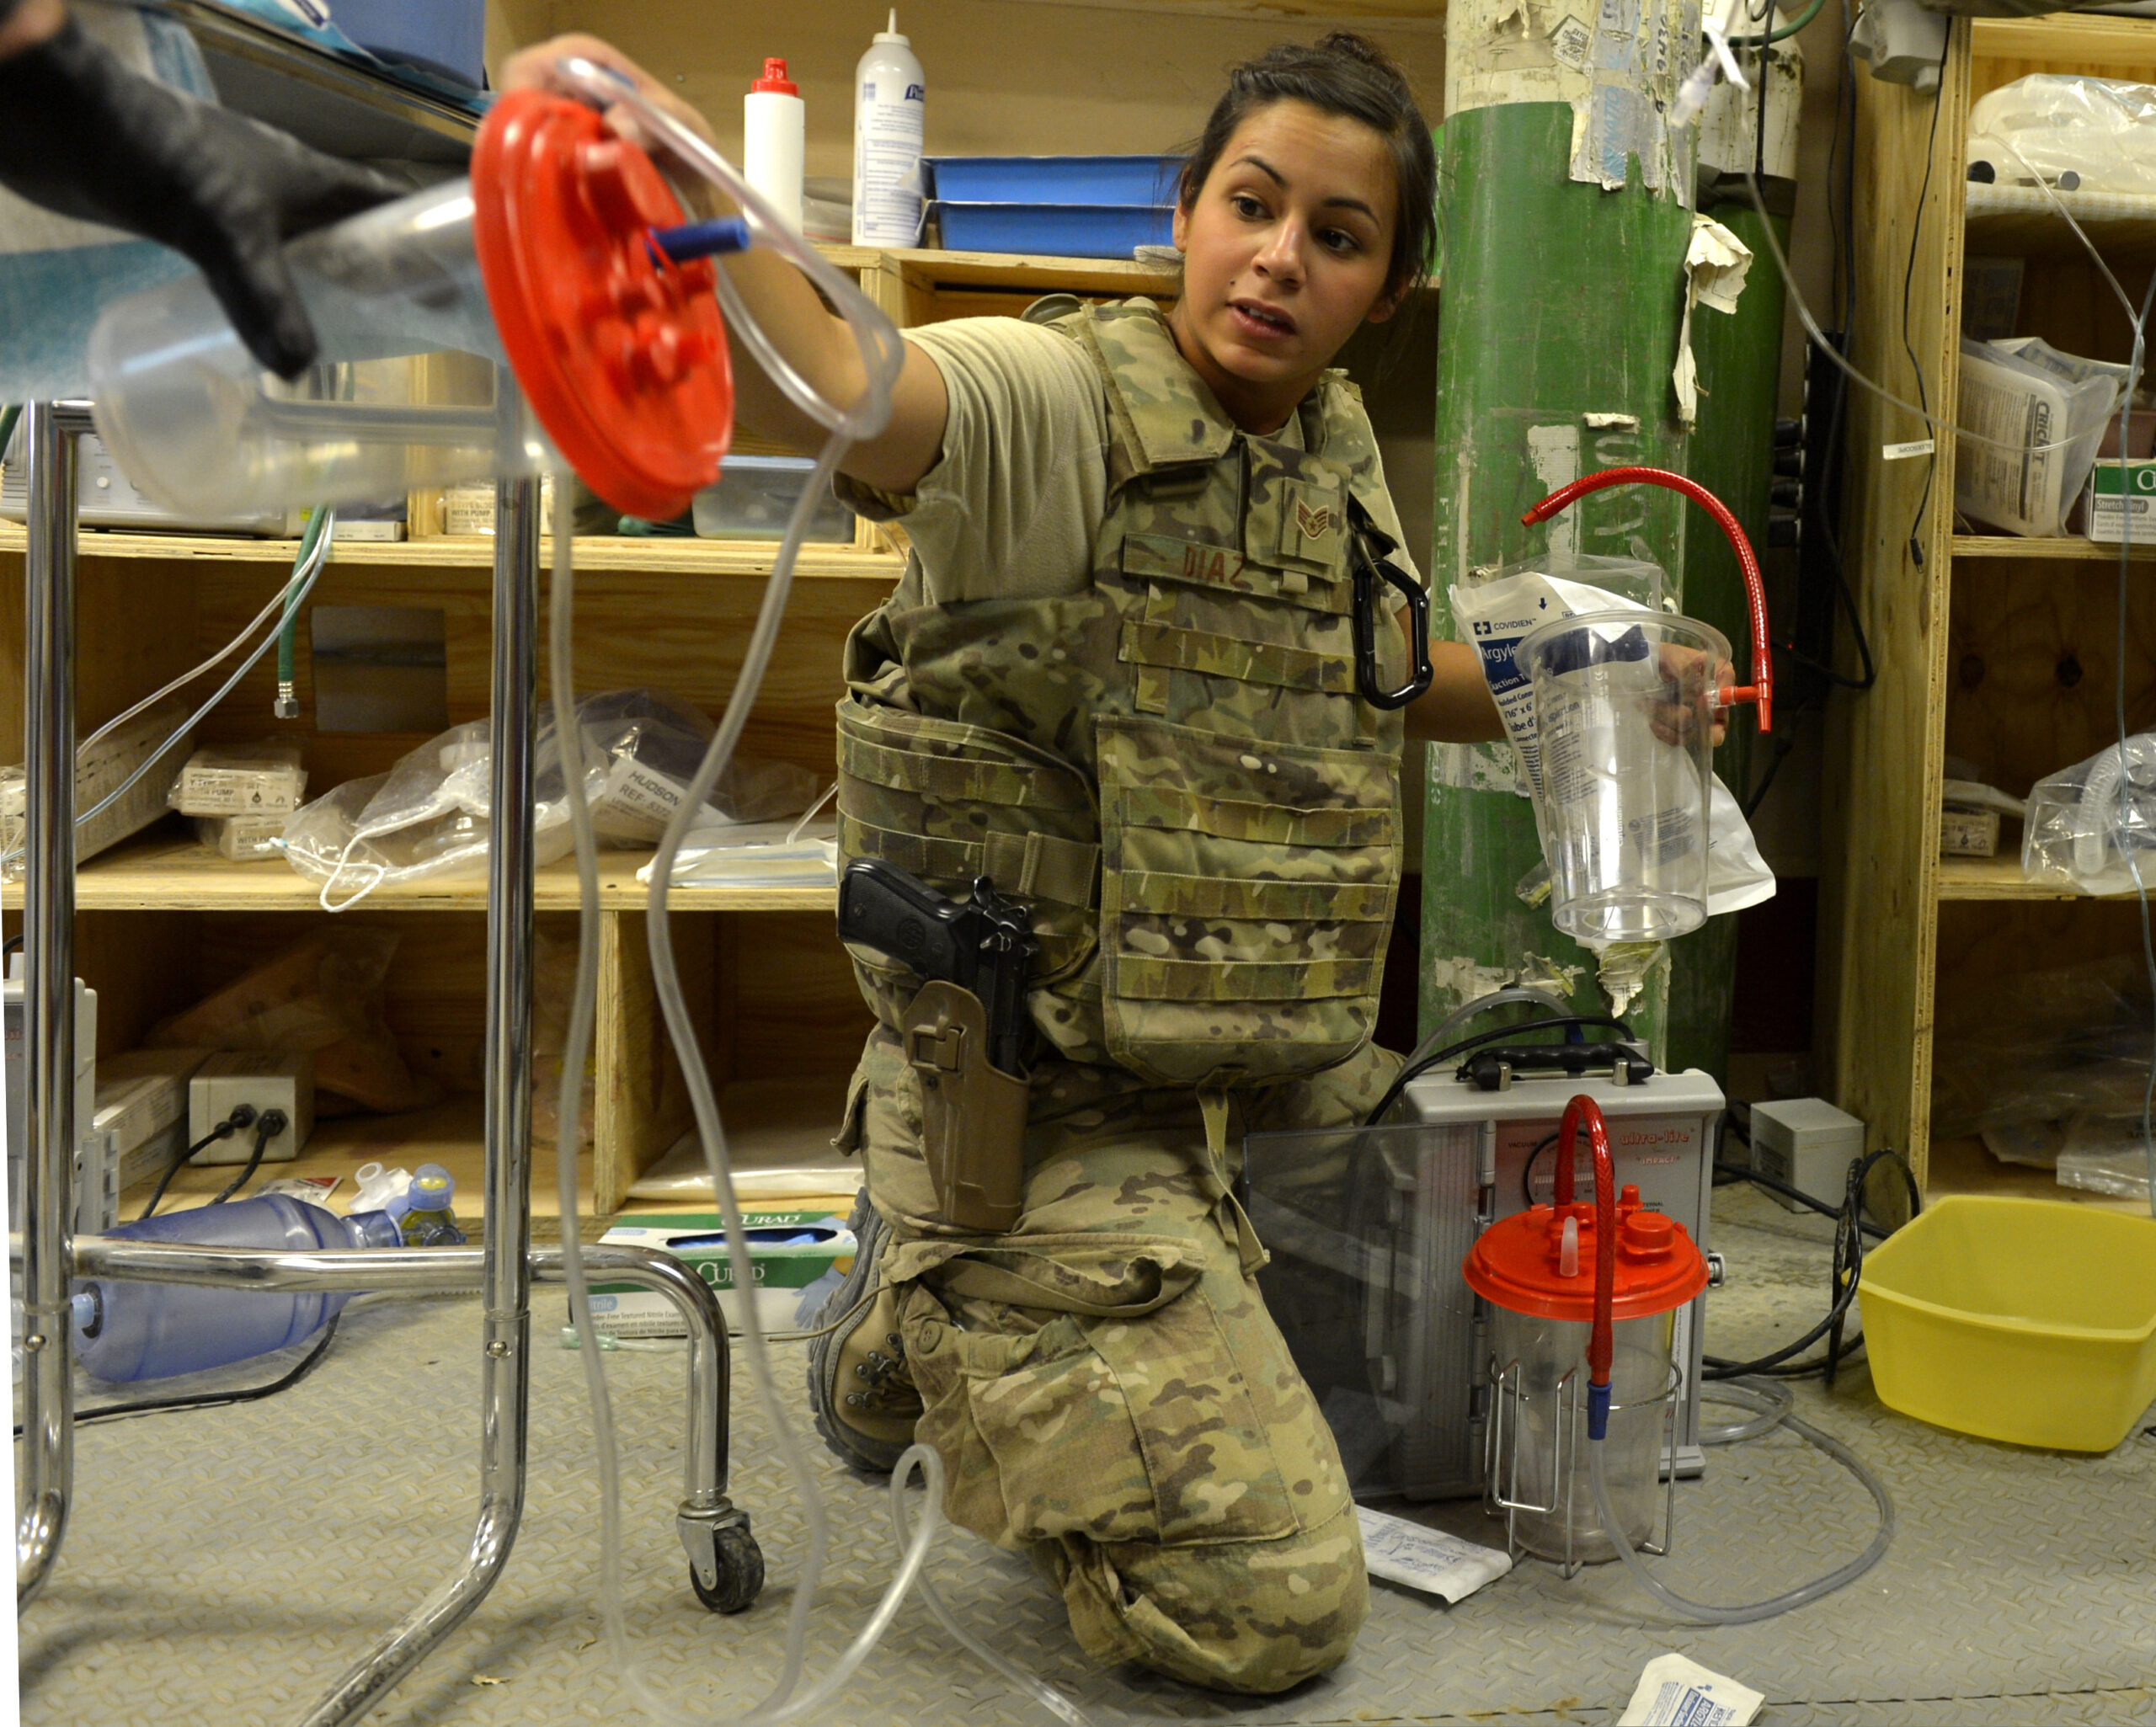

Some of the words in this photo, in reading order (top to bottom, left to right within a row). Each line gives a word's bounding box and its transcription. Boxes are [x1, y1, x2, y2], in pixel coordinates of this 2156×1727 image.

[1182, 548, 1247, 589] DIAZ
[1490, 677, 1518, 690] uction
[628, 770, 682, 806] HUDSON
[590, 1298, 613, 1311] itrile
